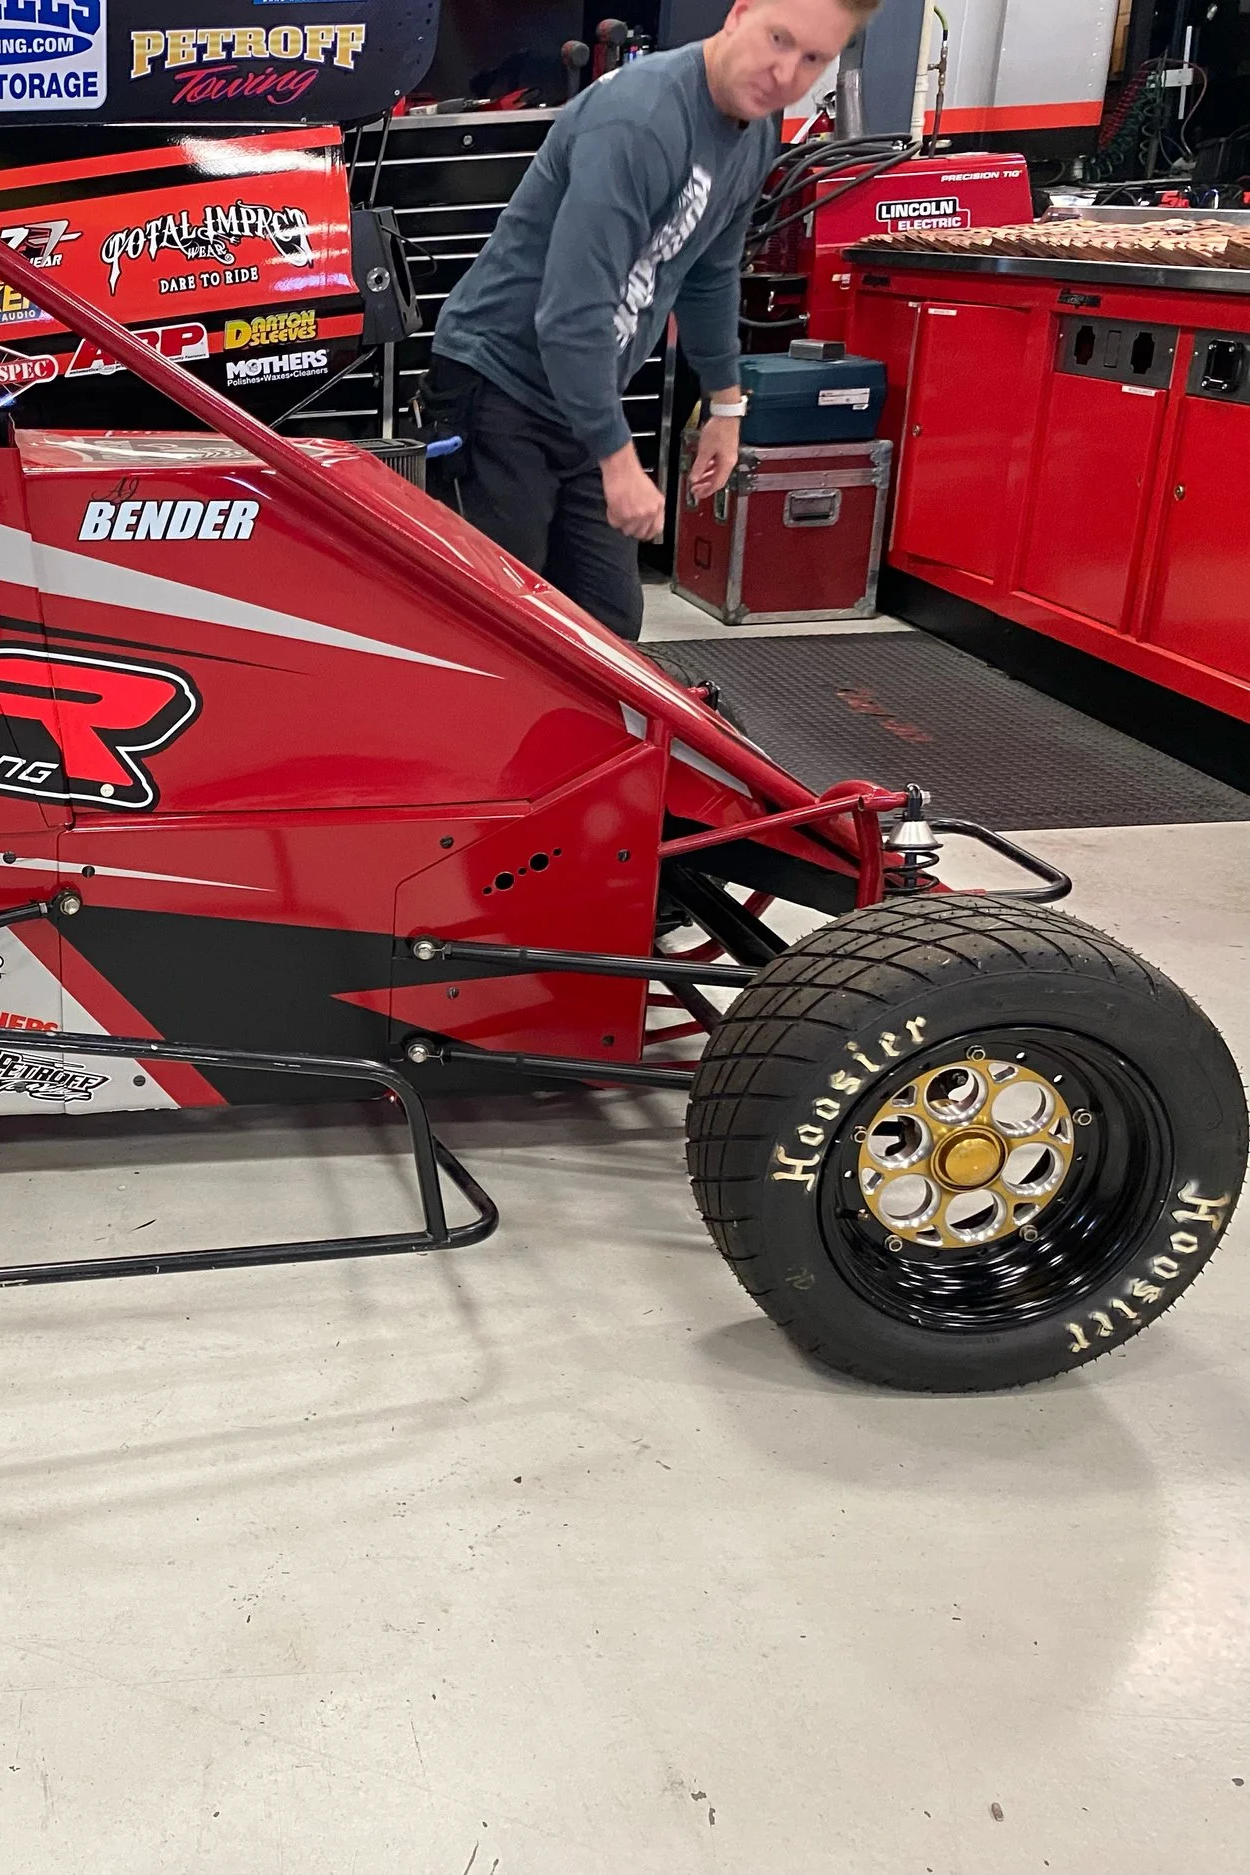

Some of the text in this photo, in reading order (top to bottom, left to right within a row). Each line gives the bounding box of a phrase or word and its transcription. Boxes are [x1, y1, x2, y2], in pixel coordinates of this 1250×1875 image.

[131, 23, 366, 79] PETROFF
[171, 65, 319, 104] Towing
[940, 171, 1000, 182] PRECISION
[881, 200, 954, 219] LINCOLN
[897, 216, 962, 231] ELECTRIC
[160, 267, 258, 293] DARE TO RIDE
[1, 309, 36, 322] AUDIO
[249, 325, 317, 346] SLEEVES
[226, 349, 328, 379] MOTHERS
[78, 499, 260, 541] BENDER
[772, 1016, 928, 1192] Hoosier
[1069, 1181, 1231, 1353] Hoosier
